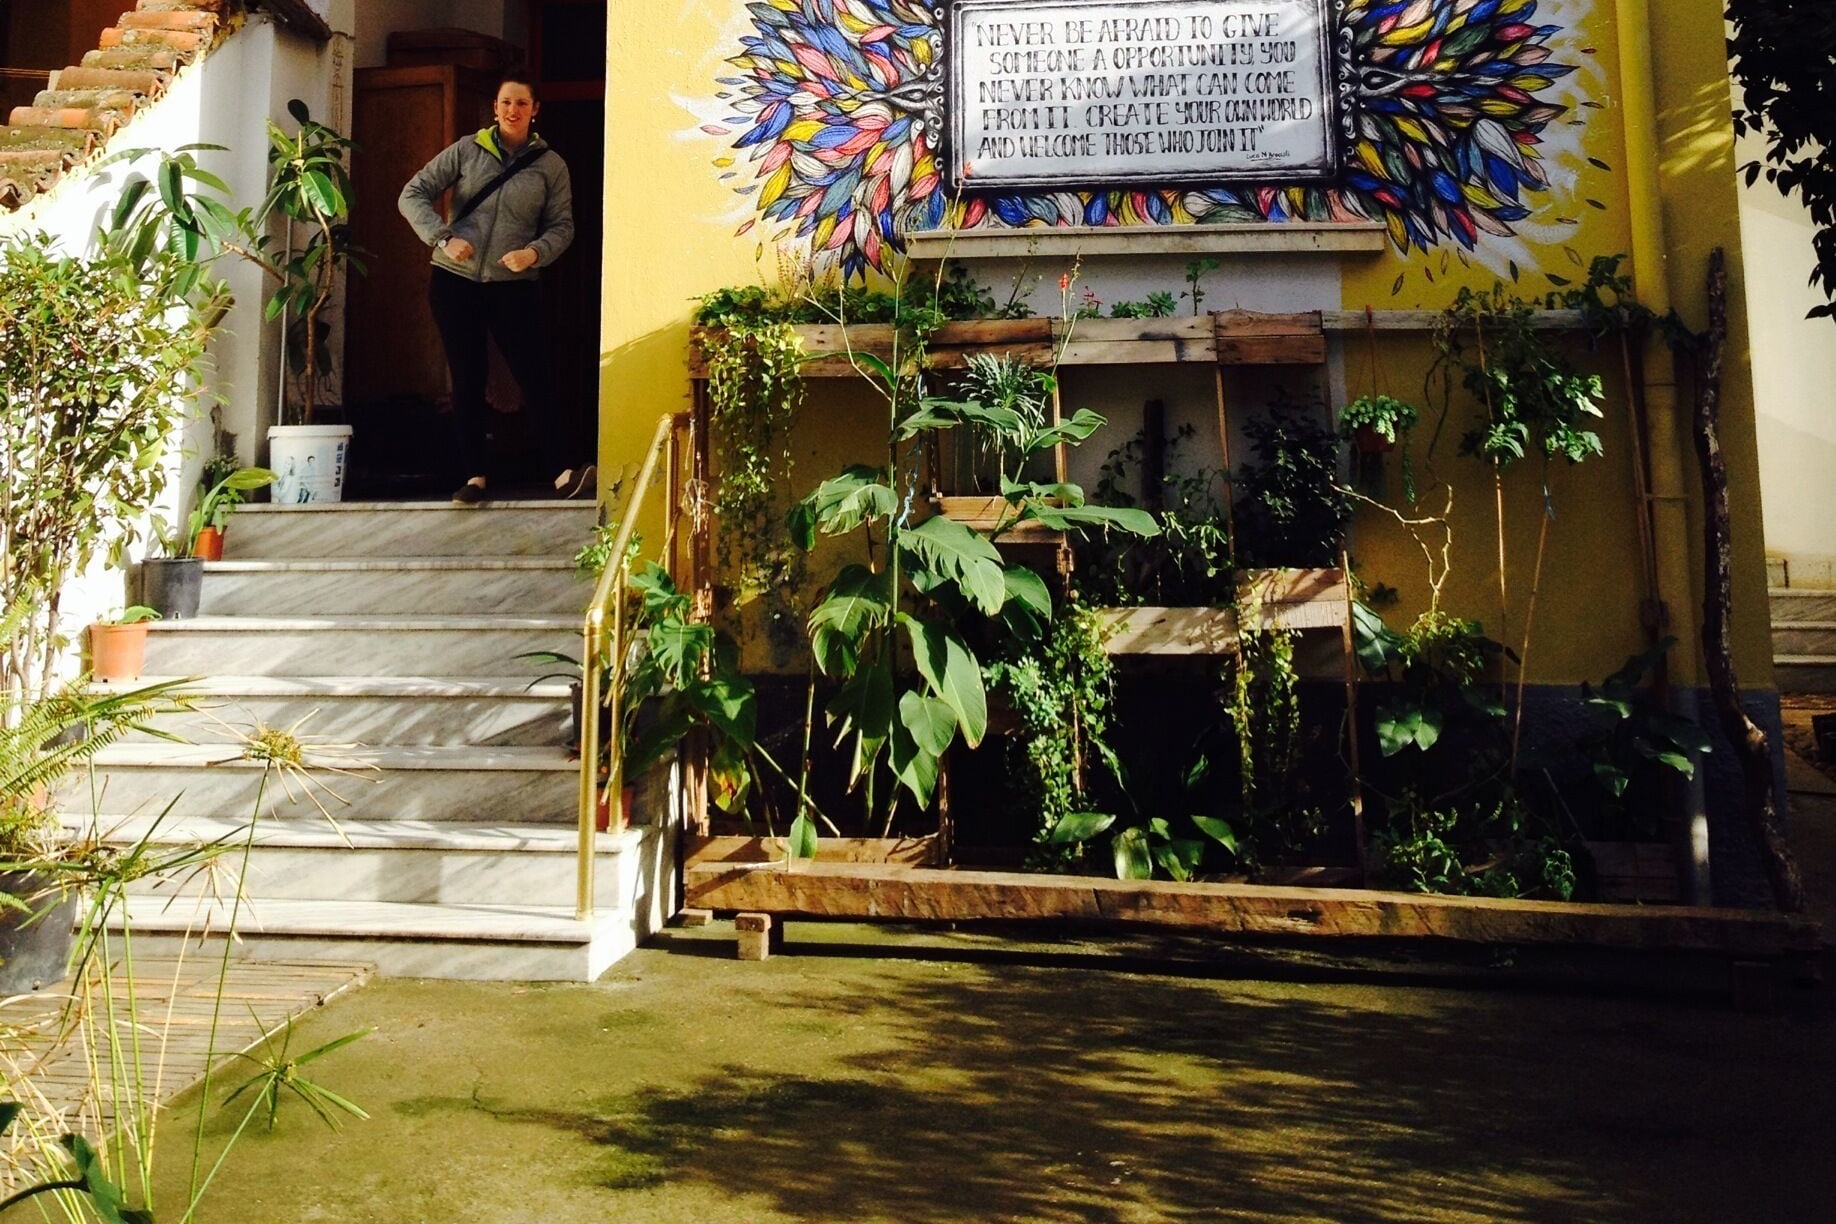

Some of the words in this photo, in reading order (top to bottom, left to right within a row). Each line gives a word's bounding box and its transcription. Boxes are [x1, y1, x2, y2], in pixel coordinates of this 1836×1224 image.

[1065, 20, 1093, 43] BE
[1098, 17, 1180, 42] AFRAID
[1184, 15, 1212, 39] TO
[1222, 12, 1279, 38] GIVE
[989, 48, 1085, 74] SOMEONE
[1092, 48, 1107, 70] A
[1260, 40, 1296, 64] YOU
[979, 78, 1053, 103] NEVER
[1060, 76, 1124, 100] KNOW
[1129, 73, 1192, 98] WHAT
[1196, 72, 1238, 95] CAN
[1244, 70, 1296, 94] COME
[982, 107, 1039, 131] FROM
[1086, 102, 1170, 127] CREATE
[1175, 100, 1221, 124] YOUR
[1225, 99, 1257, 123] OWN
[1260, 97, 1313, 122] WORLD
[977, 136, 1016, 160] AND
[1019, 133, 1097, 158] WELCOME
[1101, 131, 1155, 155] THOSE
[1158, 130, 1194, 153] WHO
[1195, 128, 1235, 153] JOIN
